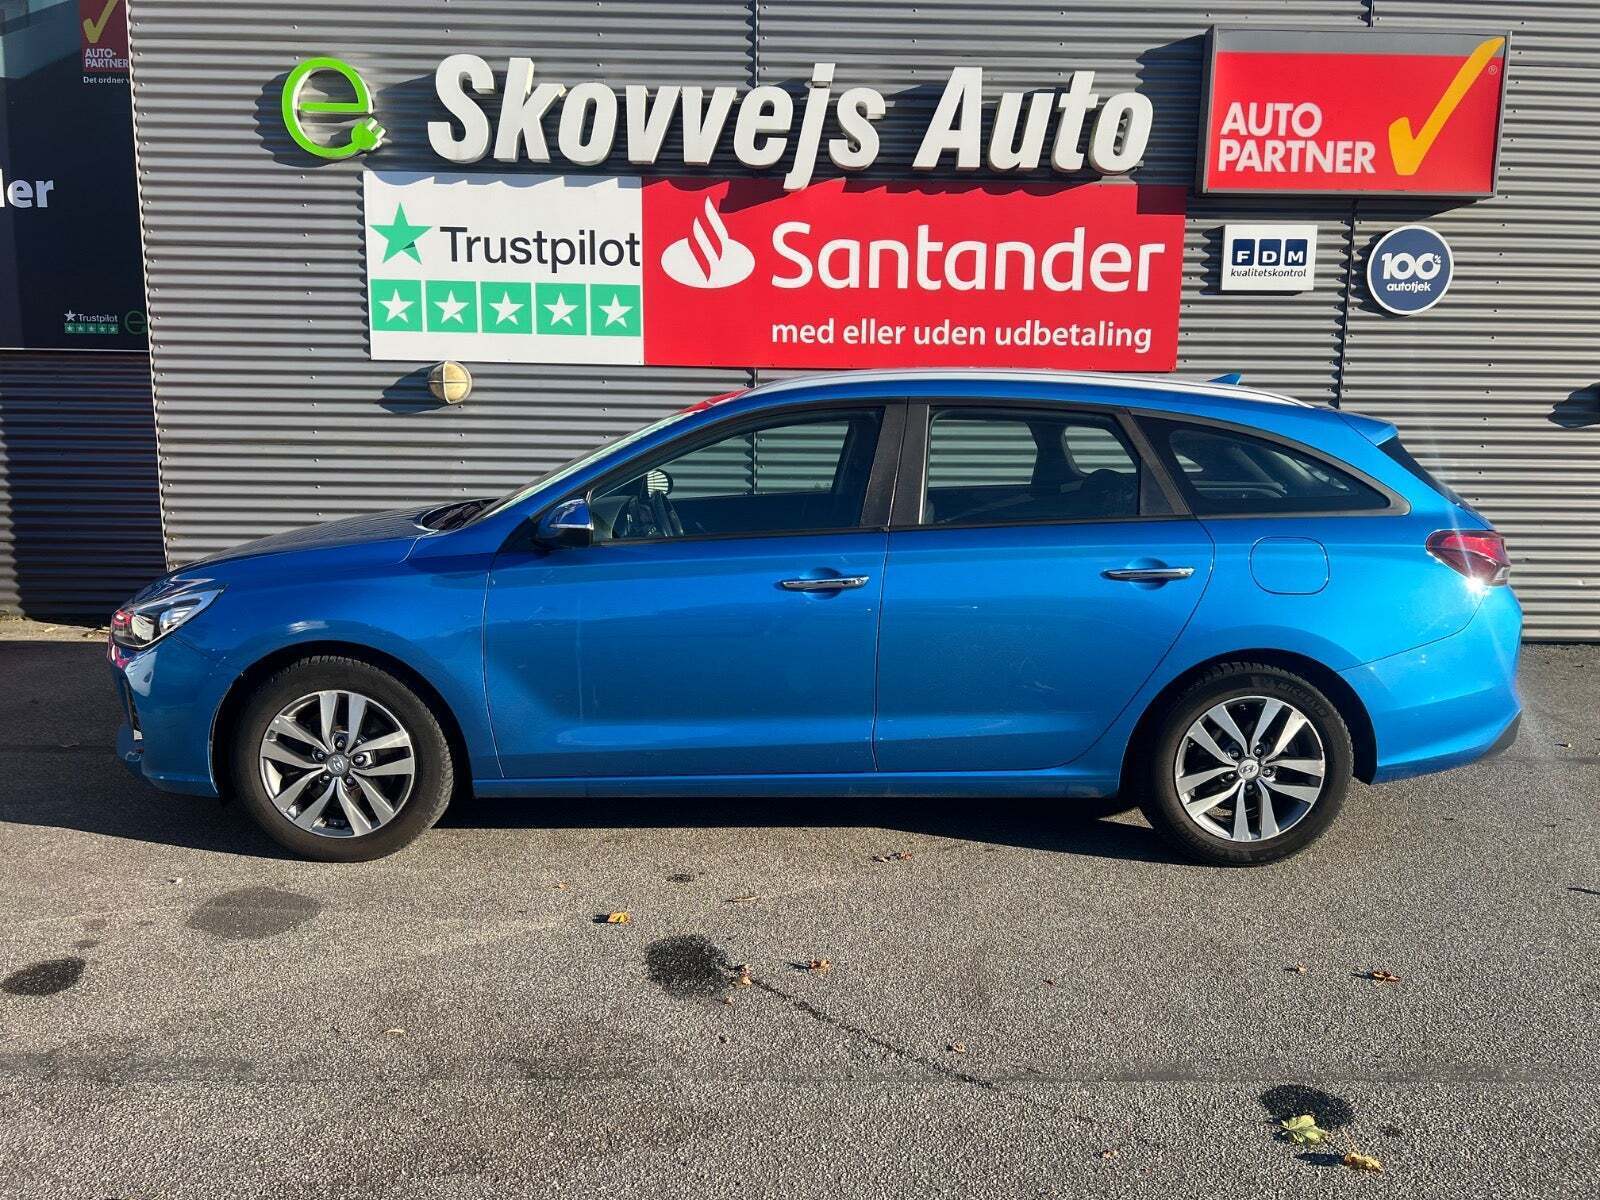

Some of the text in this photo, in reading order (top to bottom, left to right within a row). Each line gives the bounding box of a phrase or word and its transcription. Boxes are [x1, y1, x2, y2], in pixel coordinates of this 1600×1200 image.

[85, 48, 117, 58] AUTO-
[85, 58, 129, 68] PARTNER
[83, 76, 97, 84] Det
[98, 76, 124, 84] ordner
[428, 53, 887, 191] Skovvejs
[913, 66, 1154, 175] Auto
[1220, 101, 1323, 138] AUTO
[1217, 139, 1376, 174] PARTNER
[440, 226, 641, 274] Trustpilot
[771, 221, 1166, 292] Santander
[1230, 268, 1307, 278] kvalitetskontrol
[1386, 280, 1432, 294] autotjek
[78, 313, 118, 323] Trustpilot
[771, 318, 1152, 354] med eller uden udbetaling
